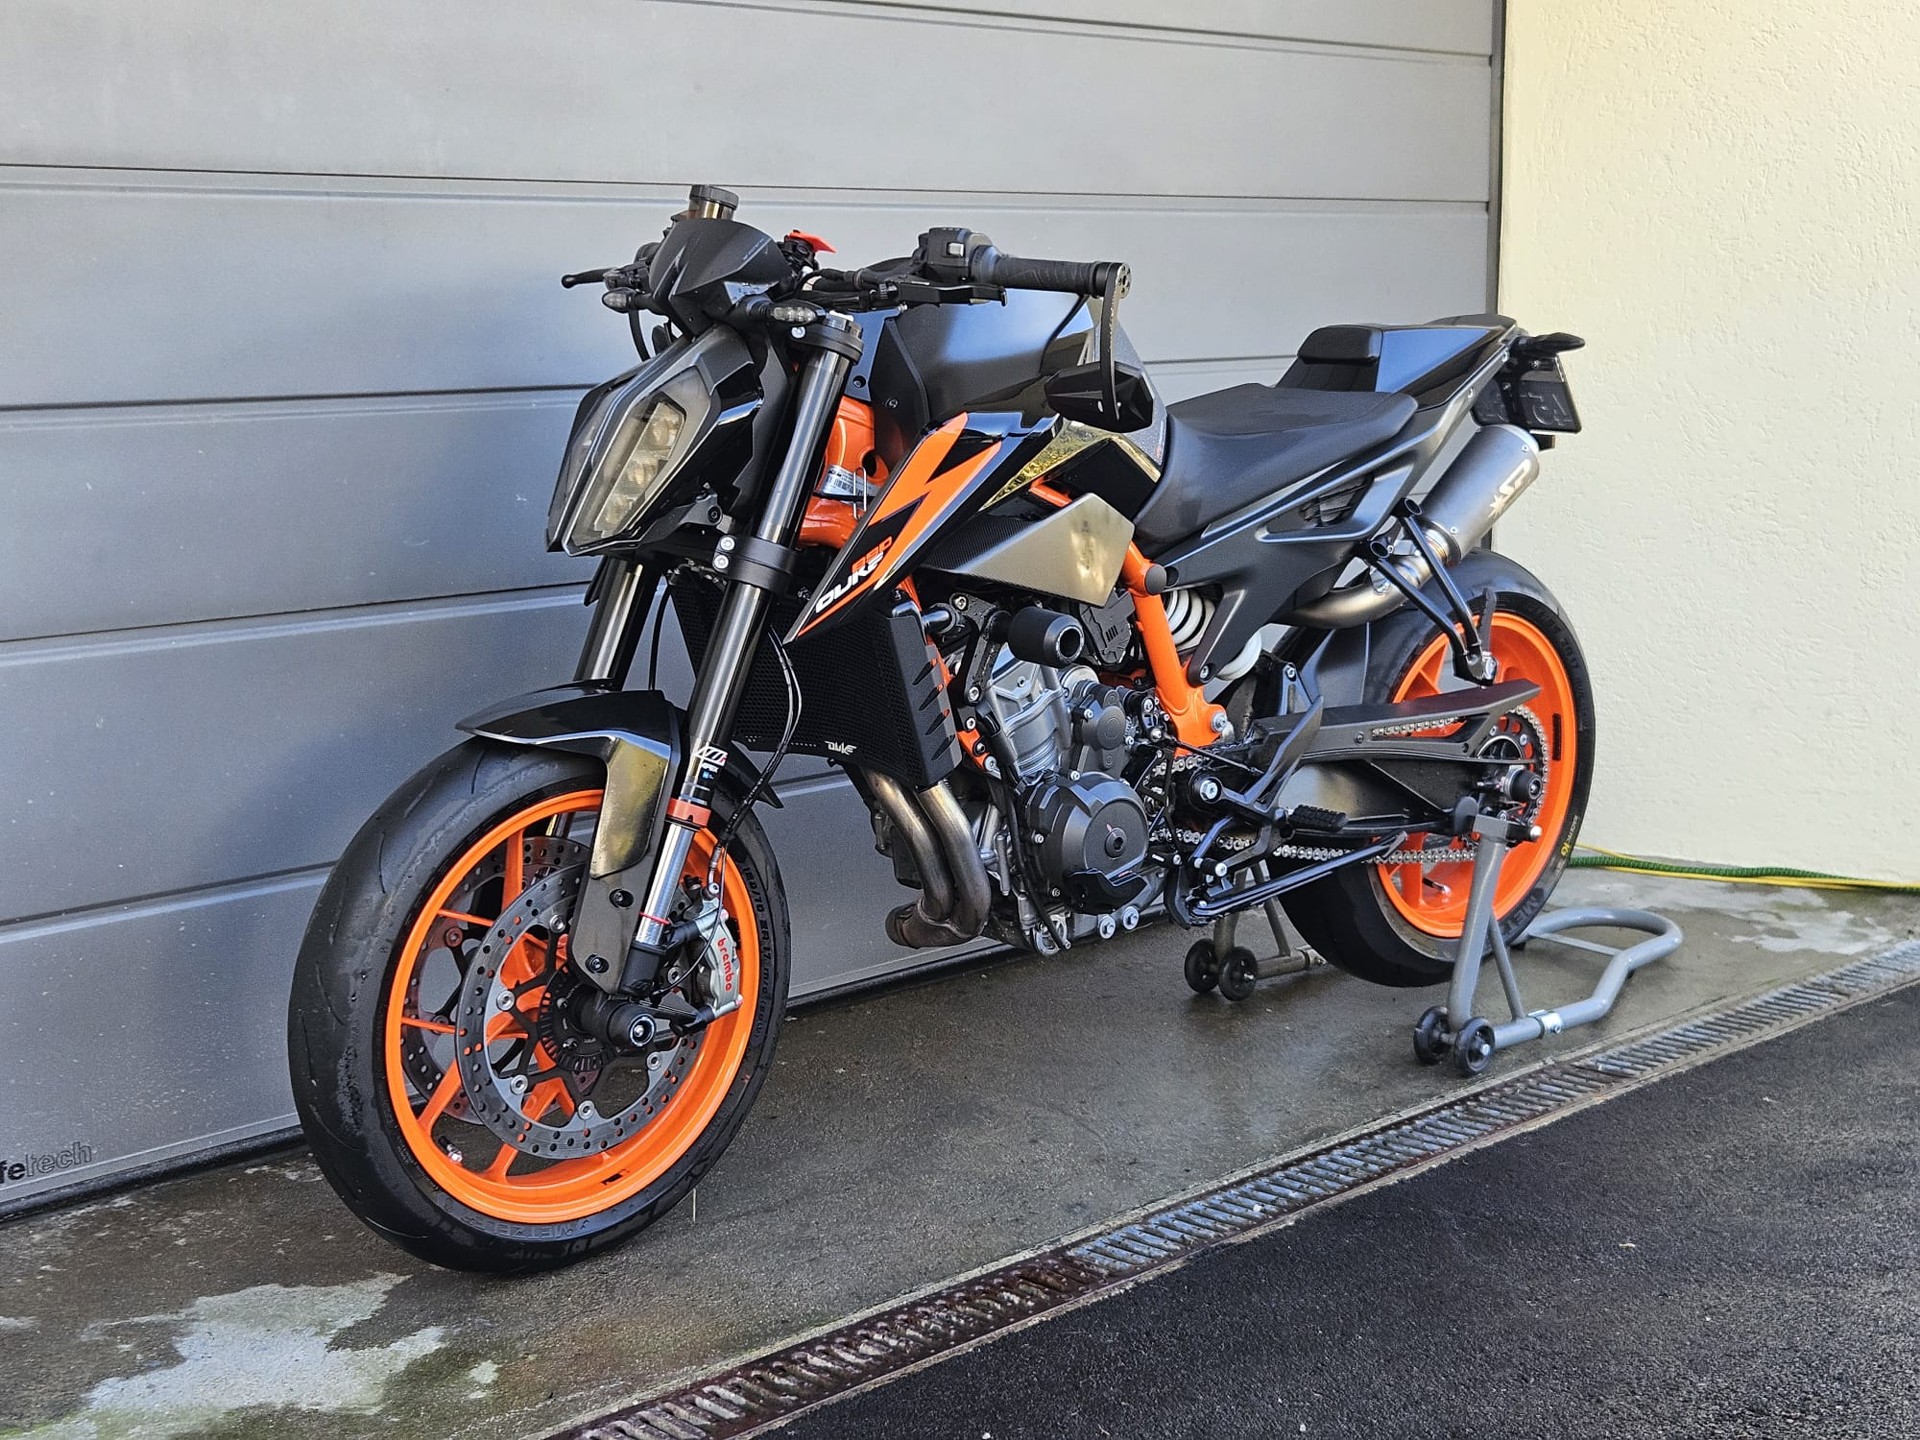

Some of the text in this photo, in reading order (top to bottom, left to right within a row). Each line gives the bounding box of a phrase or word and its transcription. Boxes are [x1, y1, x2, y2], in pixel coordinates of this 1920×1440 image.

[815, 551, 884, 613] DUKE
[824, 740, 857, 756] DUKE
[717, 937, 734, 992] brembo
